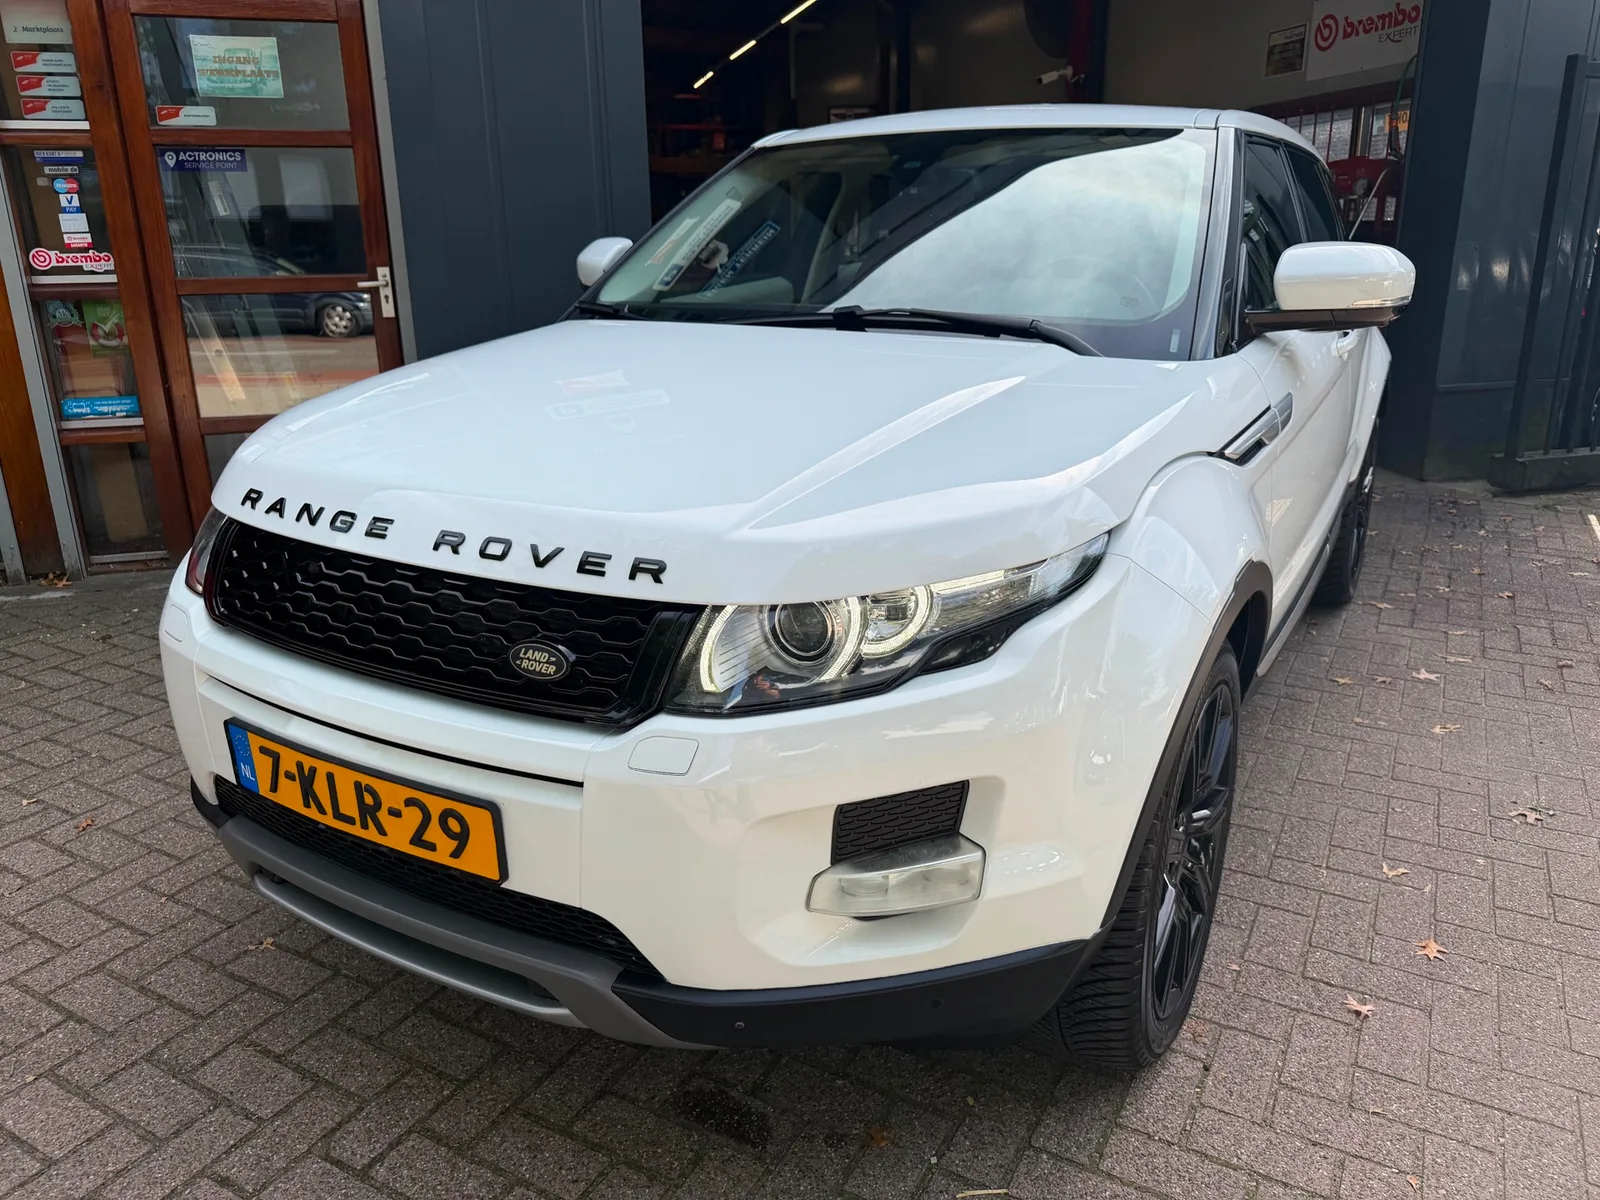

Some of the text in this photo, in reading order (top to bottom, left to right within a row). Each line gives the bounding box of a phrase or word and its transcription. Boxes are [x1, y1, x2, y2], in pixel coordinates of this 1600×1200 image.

[1342, 2, 1421, 39] brembo
[22, 26, 64, 34] Marktplaats
[1378, 26, 1419, 43] EXPERT
[213, 56, 260, 65] INGANG
[179, 151, 241, 161] ACTRONICS
[184, 161, 214, 169] SERVICE
[55, 251, 112, 264] brembo
[240, 487, 669, 584] RANGE ROVER
[519, 647, 549, 663] LAND
[521, 659, 556, 675] ROVER
[240, 762, 255, 781] NL
[258, 745, 470, 860] 7-KLR-29
